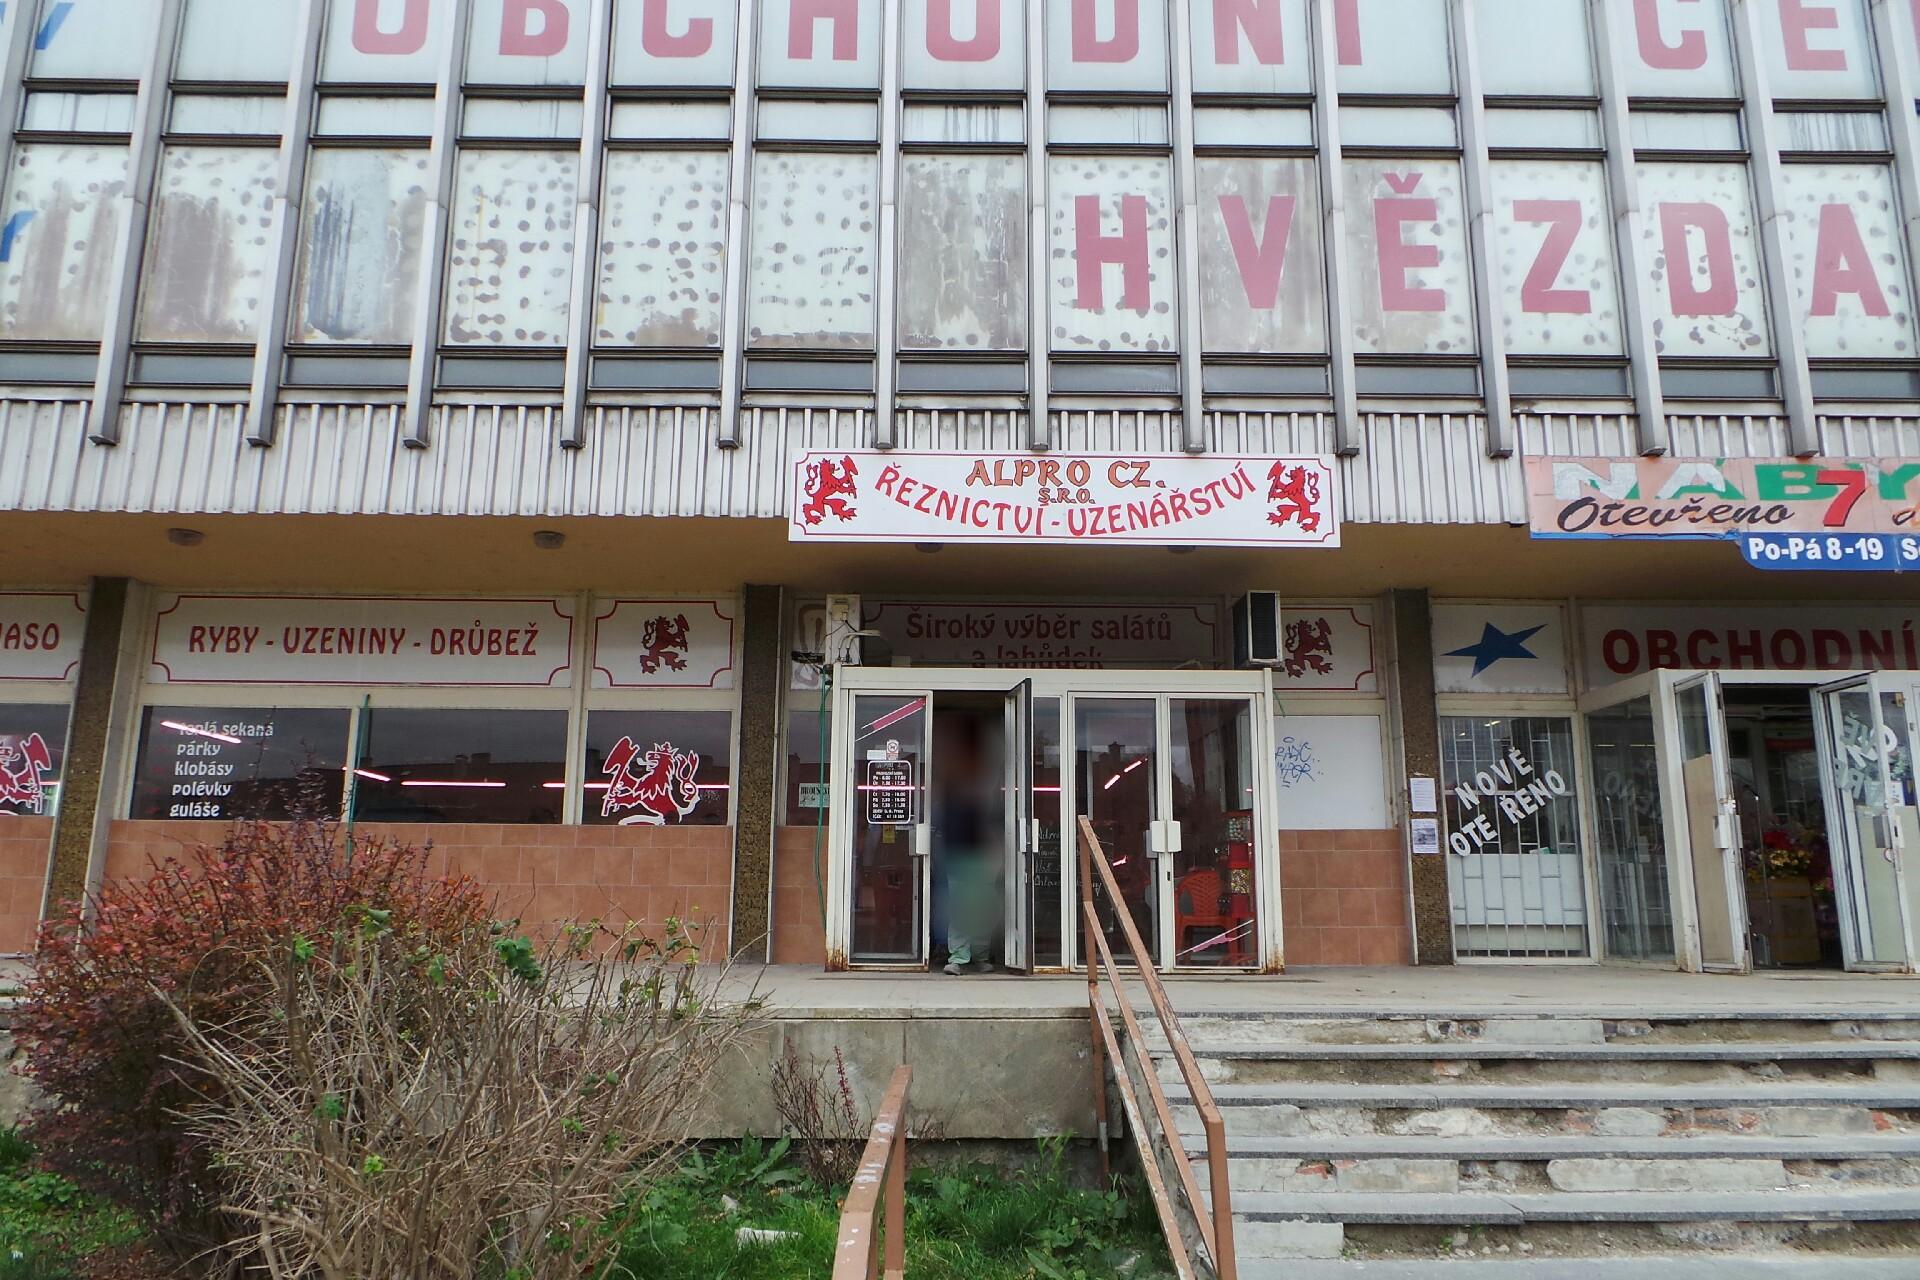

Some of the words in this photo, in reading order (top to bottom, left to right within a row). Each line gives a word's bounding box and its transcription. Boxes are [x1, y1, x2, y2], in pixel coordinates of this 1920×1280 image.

[1632, 0, 1920, 71] CE
[1073, 173, 1890, 316] HVĚZDA
[965, 459, 1090, 488] ALPRO
[1107, 460, 1166, 488] CZ.
[875, 462, 1049, 535] ŘEZNICTVÍ
[1067, 461, 1257, 537] UZENÁŘSTVÍ
[1557, 497, 1795, 532] Otevřeno
[1816, 470, 1866, 527] 7
[1749, 537, 1822, 560] Po-Pá
[1901, 538, 1920, 561] S
[0, 622, 60, 650] ASO
[189, 625, 260, 654] RYBY
[283, 626, 406, 655] UZENINY
[430, 619, 539, 656] DRŮBEŽ
[907, 606, 995, 639] Široký
[1005, 613, 1080, 640] výběr
[1091, 612, 1171, 641] salátů
[1603, 619, 1920, 674] OBCHODNÍ
[222, 722, 274, 736] sekaná
[177, 741, 221, 756] párky
[175, 761, 234, 776] klobásy
[1455, 746, 1533, 811] NOVĚ
[172, 781, 232, 796] polévky
[169, 801, 220, 817] guláše
